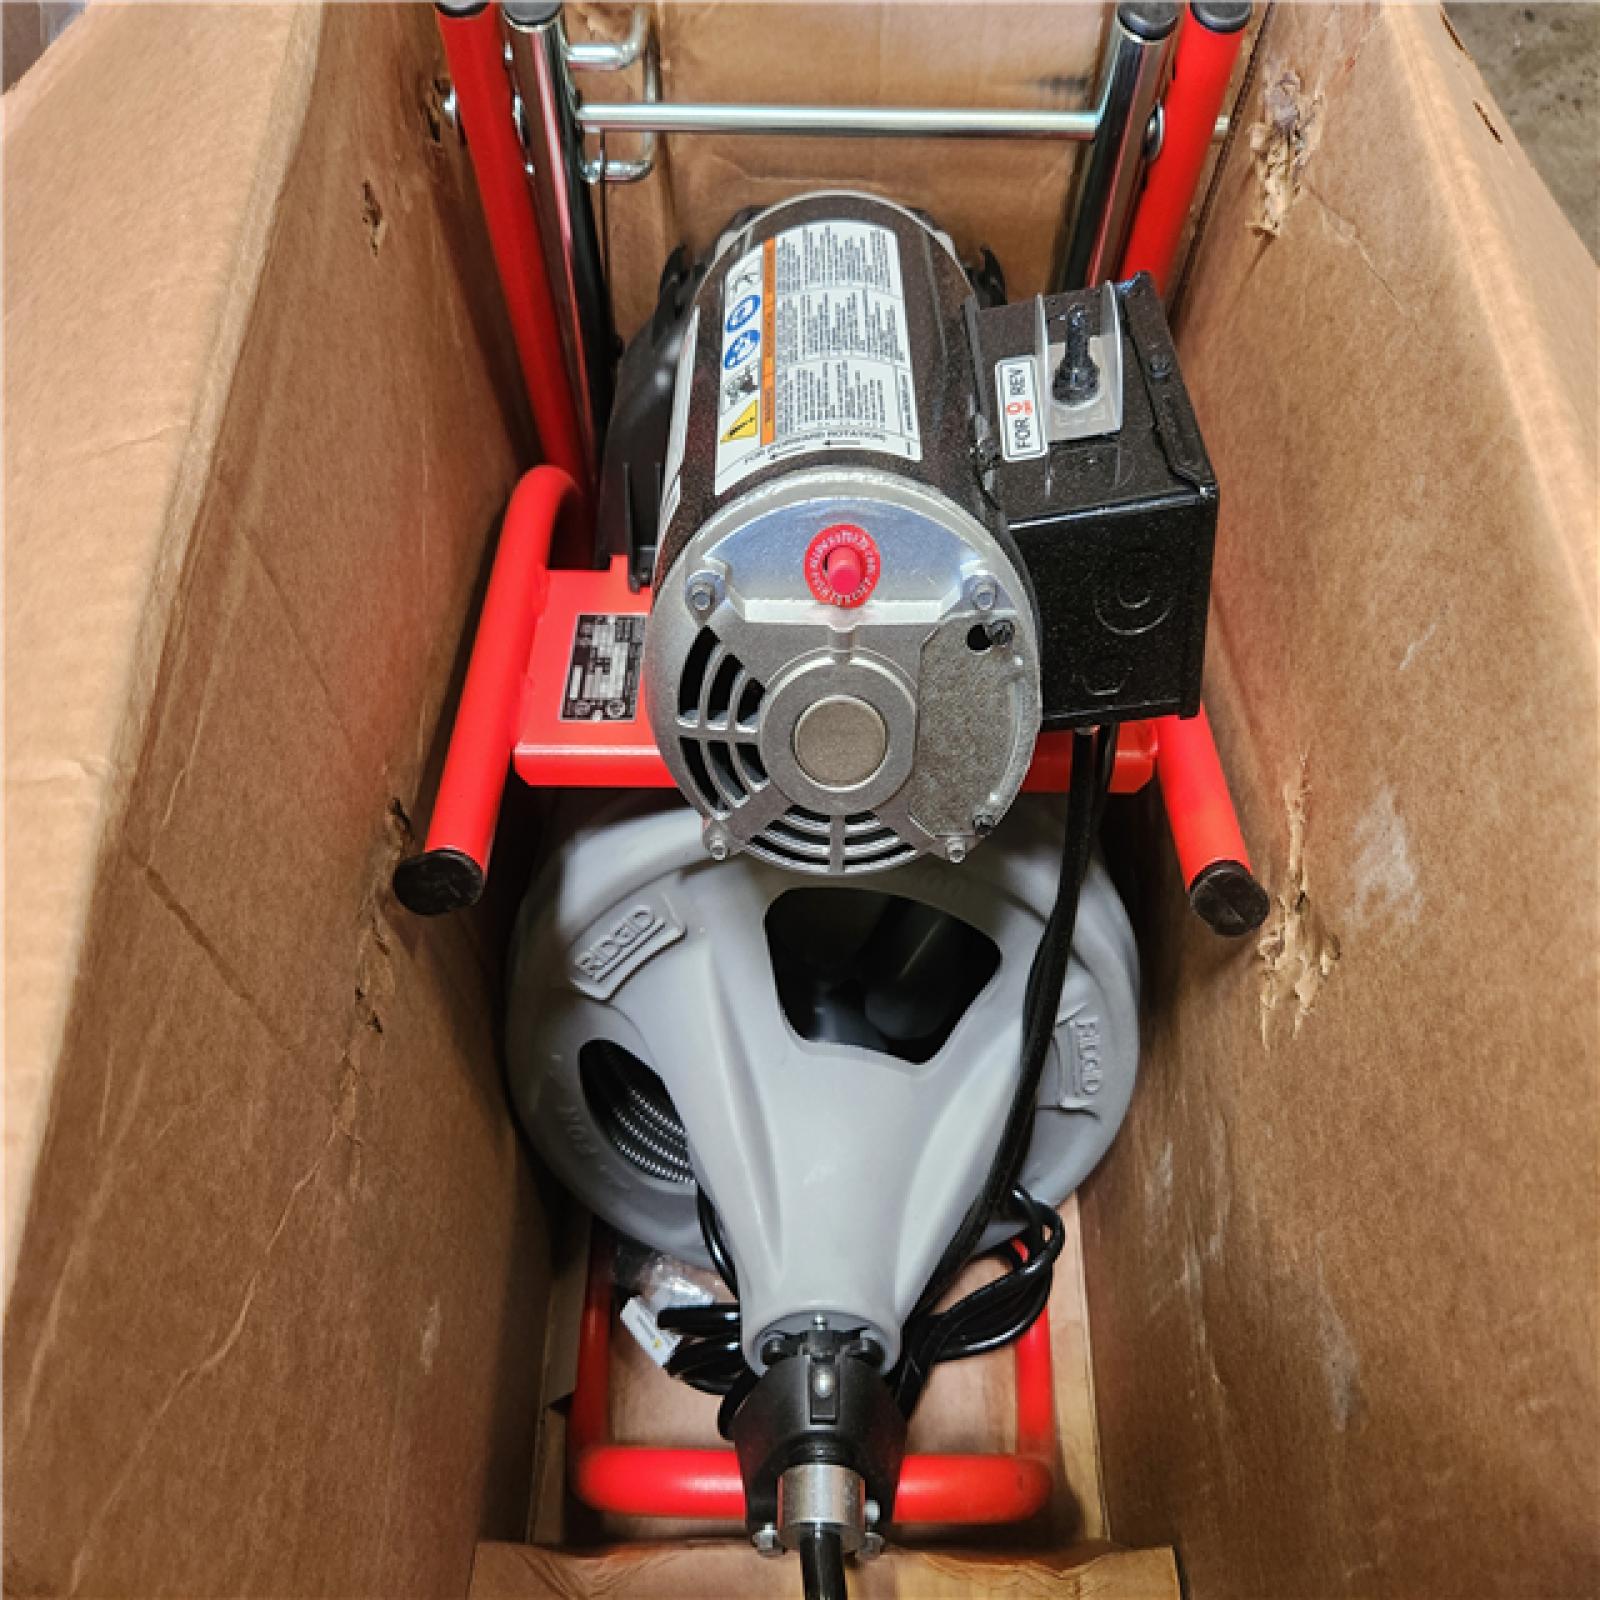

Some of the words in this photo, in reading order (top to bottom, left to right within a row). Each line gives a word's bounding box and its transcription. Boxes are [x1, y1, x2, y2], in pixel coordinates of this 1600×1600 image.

[1008, 368, 1026, 396] REV
[1014, 417, 1032, 448] FOR
[575, 905, 654, 978] RIDGID
